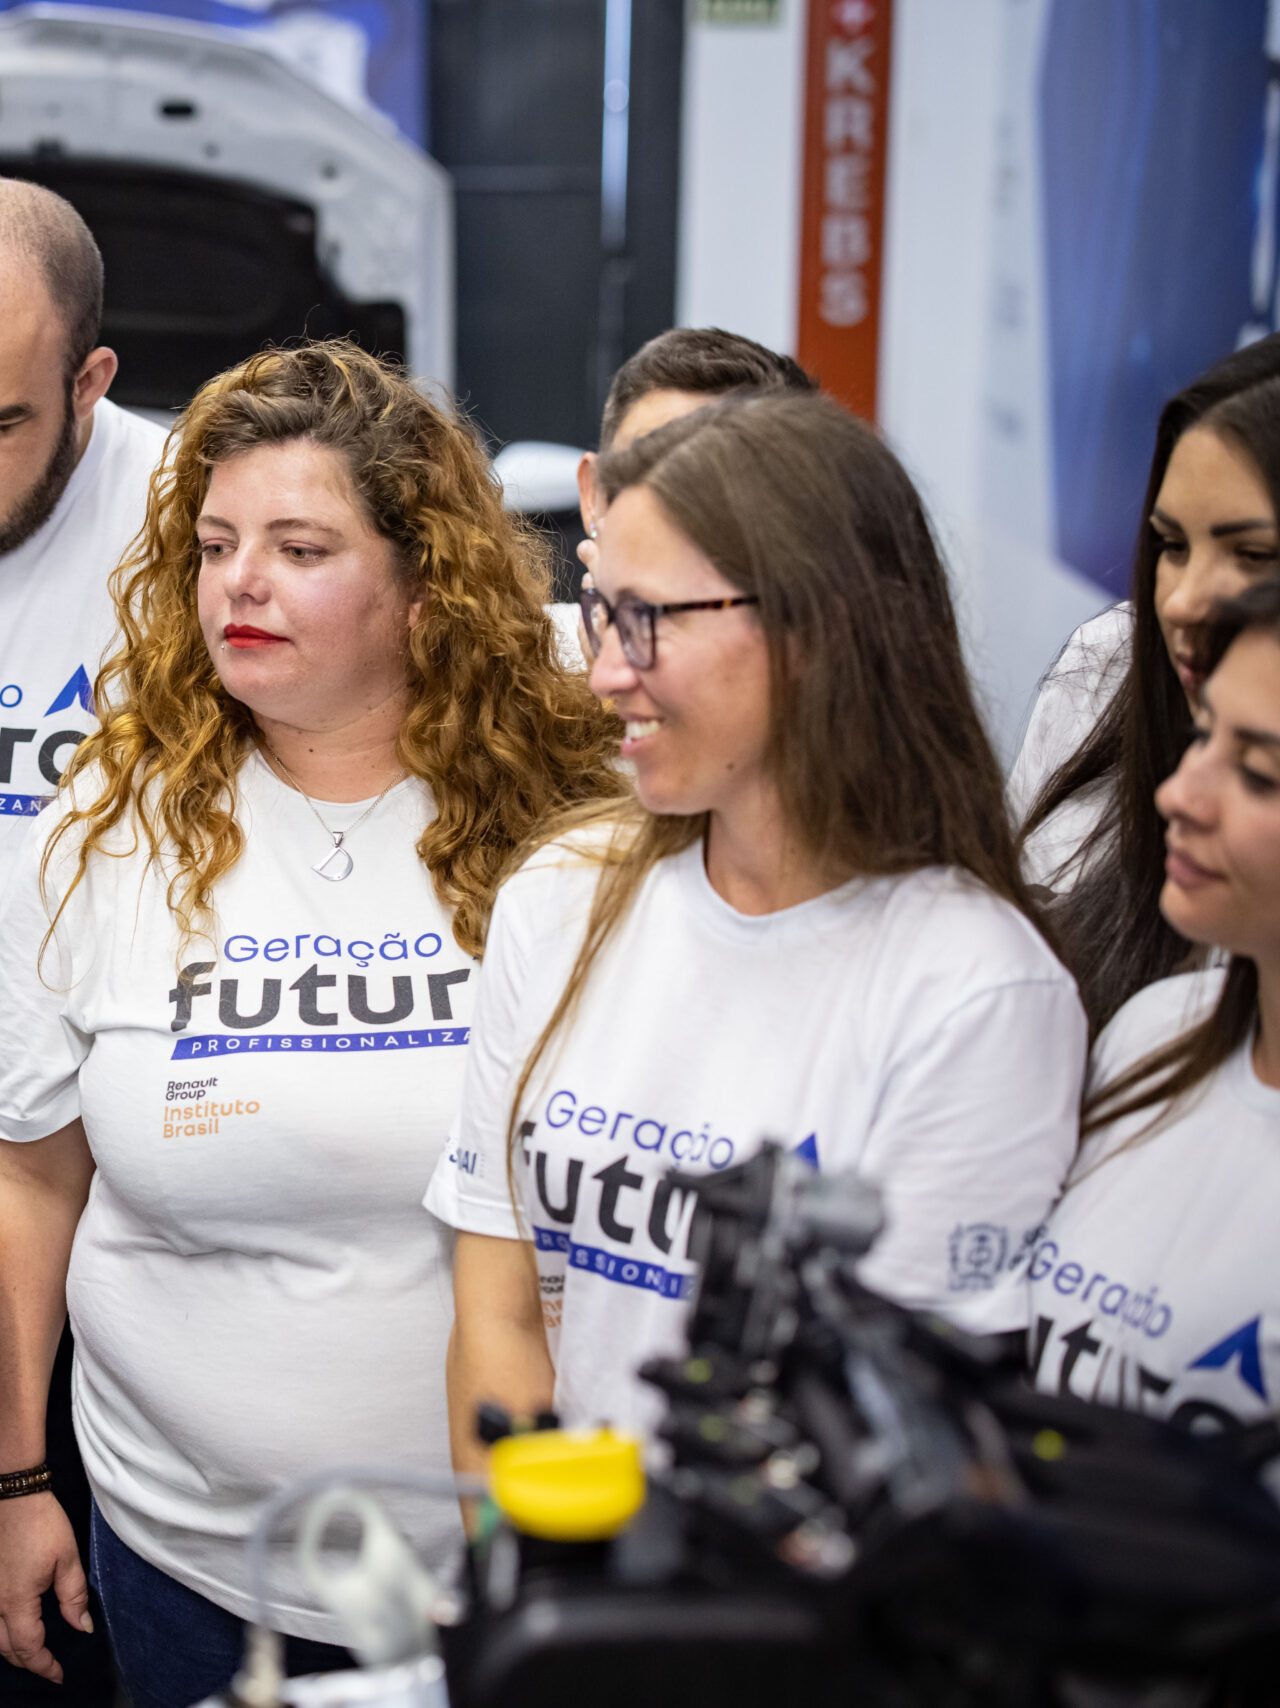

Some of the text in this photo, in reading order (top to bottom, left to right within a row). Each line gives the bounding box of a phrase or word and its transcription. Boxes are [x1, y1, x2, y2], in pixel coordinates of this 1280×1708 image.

[819, 38, 875, 328] KREBS
[224, 932, 443, 968] Geração
[169, 961, 470, 1032] futur
[166, 1089, 206, 1101] Group
[167, 1077, 218, 1091] Renault
[164, 1100, 260, 1122] Instituto
[163, 1119, 219, 1139] Brasil
